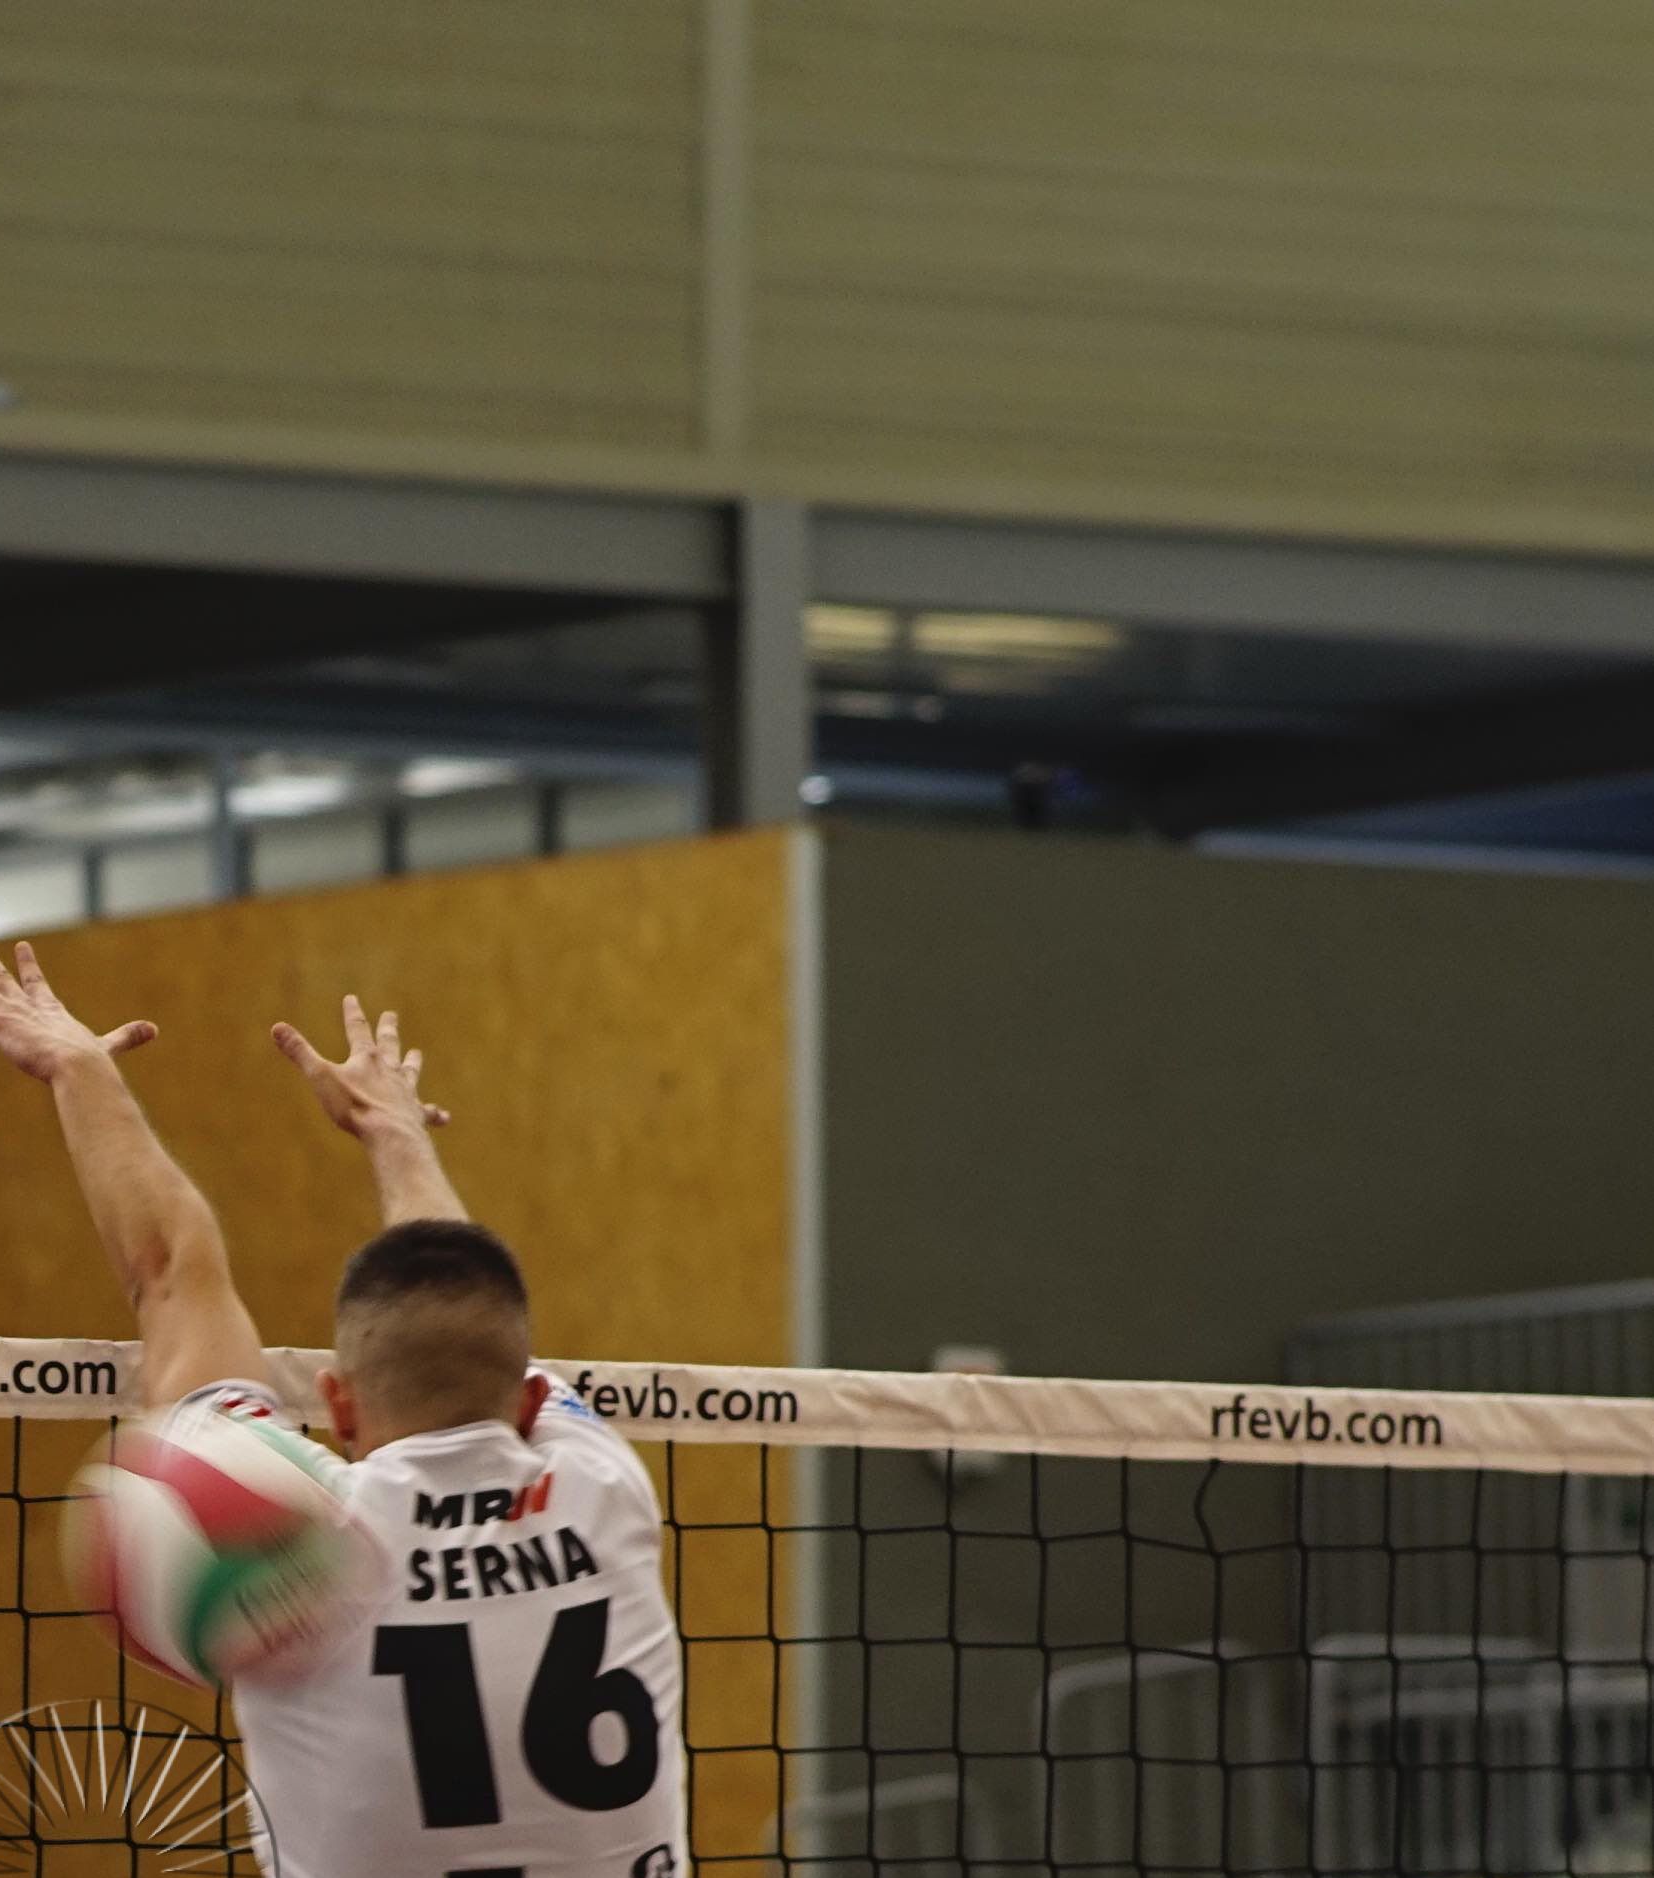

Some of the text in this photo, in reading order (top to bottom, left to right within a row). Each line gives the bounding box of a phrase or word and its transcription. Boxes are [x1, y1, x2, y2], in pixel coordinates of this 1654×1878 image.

[573, 1370, 798, 1423] fevb.com
[1211, 1393, 1442, 1446] rfevb.com
[406, 1526, 599, 1601] SERNA
[371, 1597, 659, 1829] 16
